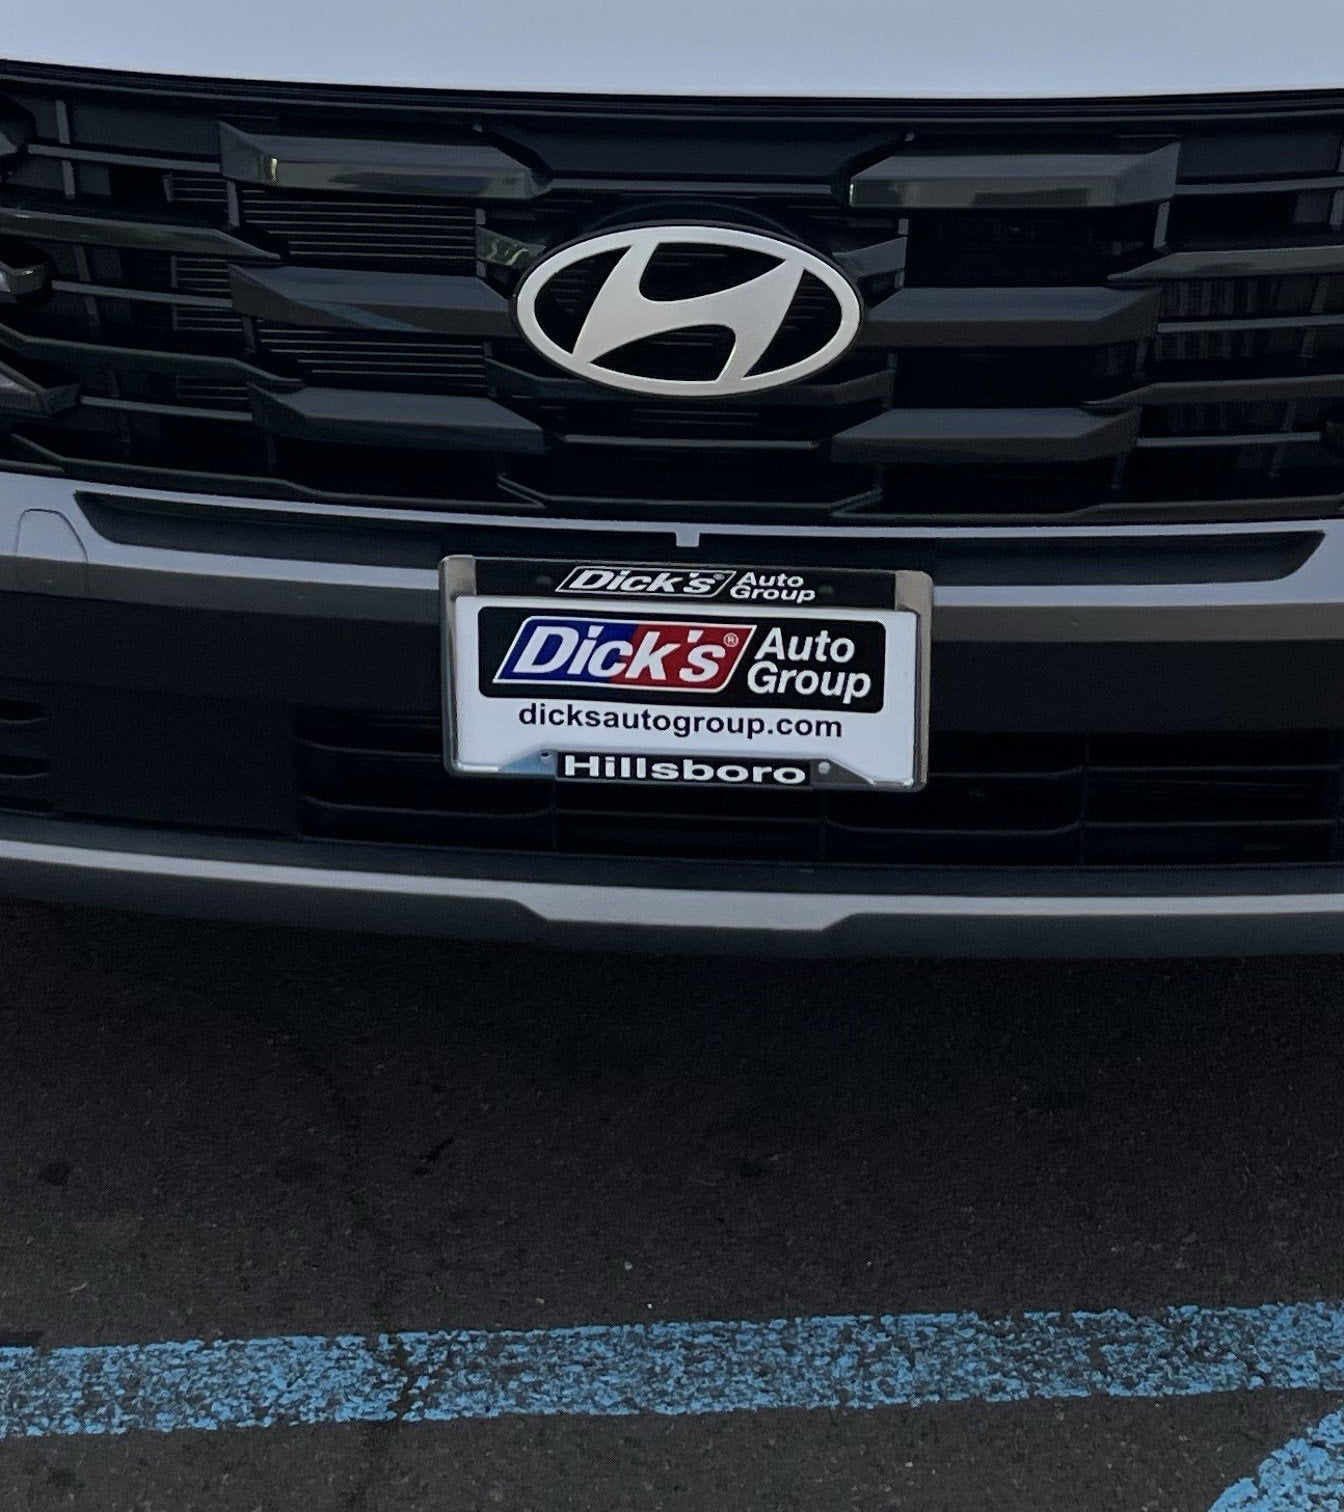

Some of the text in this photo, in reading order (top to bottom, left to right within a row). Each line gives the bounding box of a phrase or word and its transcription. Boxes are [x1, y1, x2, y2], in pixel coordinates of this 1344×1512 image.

[567, 567, 805, 595] Dick's Auto
[729, 586, 817, 604] Group
[511, 624, 856, 684] Dick's Auto
[747, 662, 872, 705] Group
[519, 702, 843, 740] dicksautogroup.com
[563, 754, 807, 786] Hillsboro
